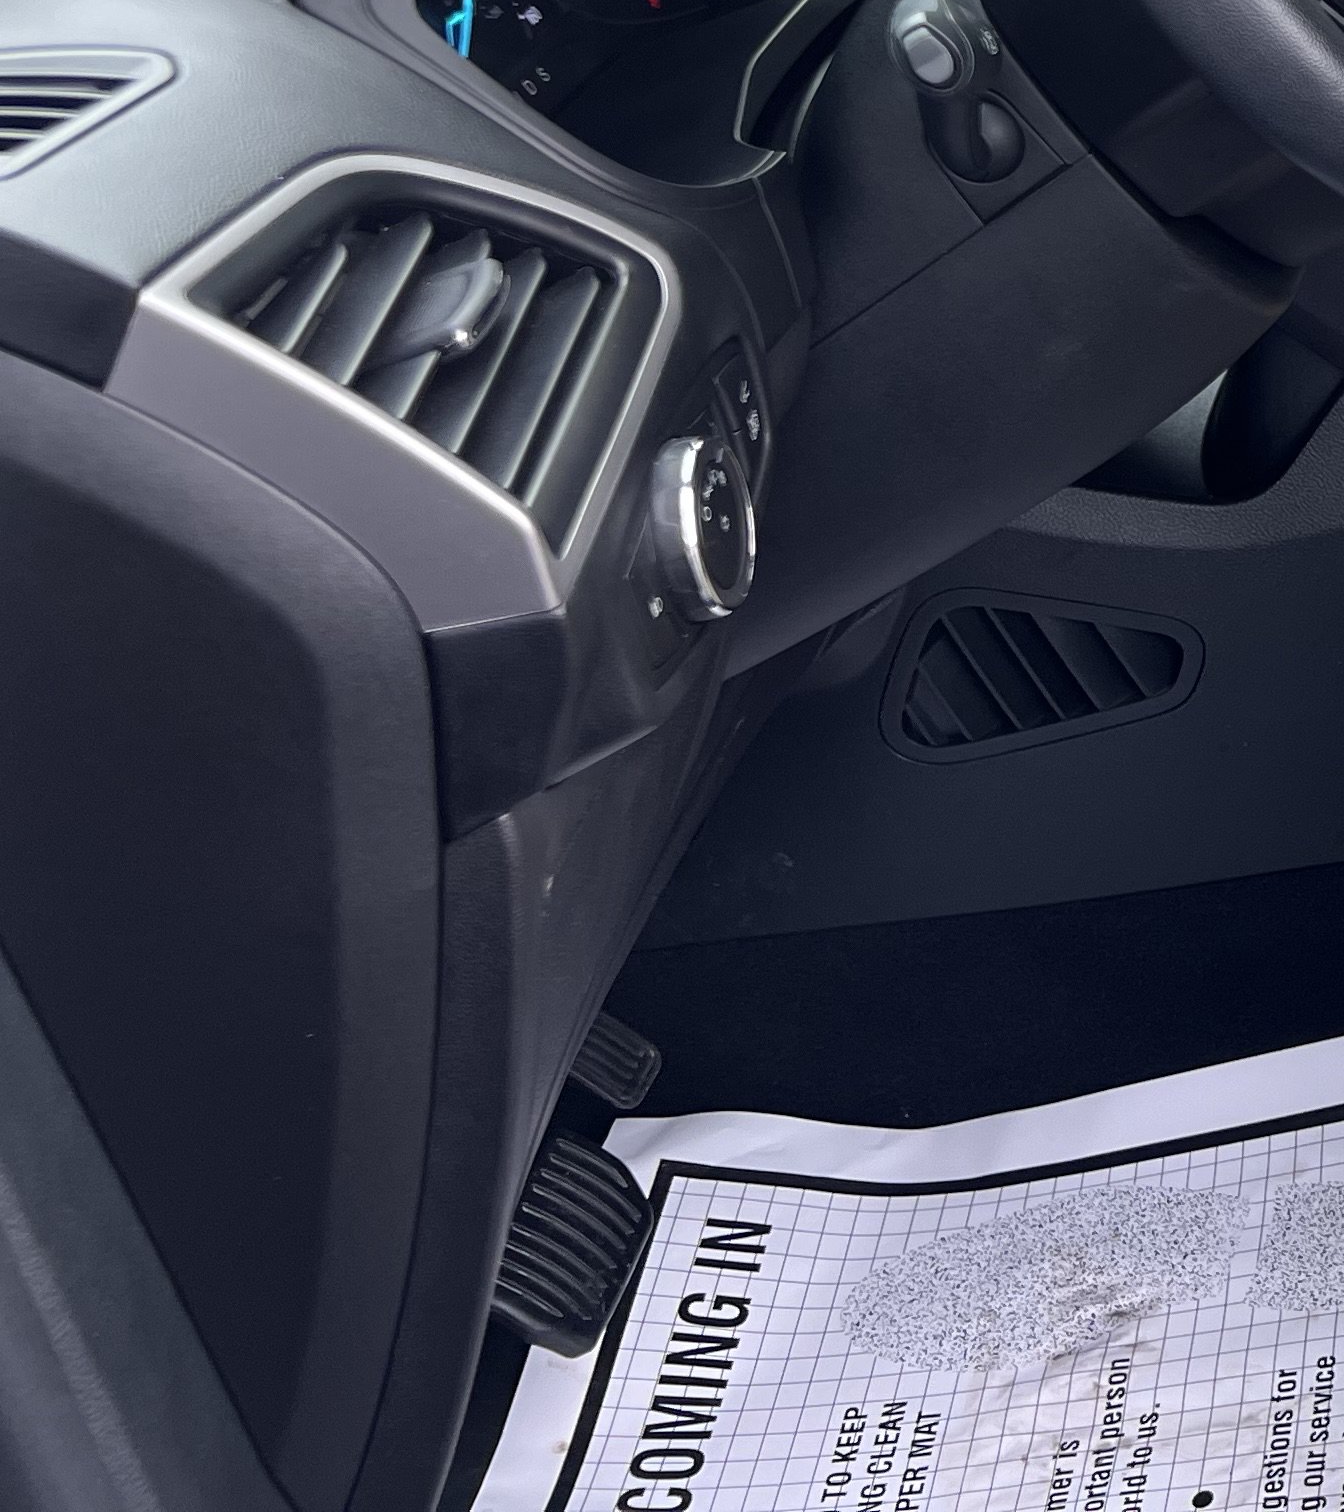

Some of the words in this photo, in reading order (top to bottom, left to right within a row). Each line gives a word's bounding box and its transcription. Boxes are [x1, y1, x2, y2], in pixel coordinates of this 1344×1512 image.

[615, 1291, 752, 1512] COMING
[693, 1217, 774, 1274] IN
[1271, 1368, 1298, 1403] for
[1136, 1400, 1162, 1441] us.
[1309, 1355, 1336, 1443] service
[832, 1406, 868, 1465] KEEP
[867, 1400, 908, 1475] CLEAN
[908, 1410, 941, 1459] MAT
[1052, 1439, 1080, 1460] is
[1083, 1446, 1116, 1512] ortant
[1100, 1357, 1131, 1439] person
[1127, 1444, 1152, 1470] to
[1262, 1408, 1294, 1512] gestions
[1304, 1450, 1327, 1487] our
[821, 1471, 852, 1502] TO
[893, 1465, 929, 1512] PER
